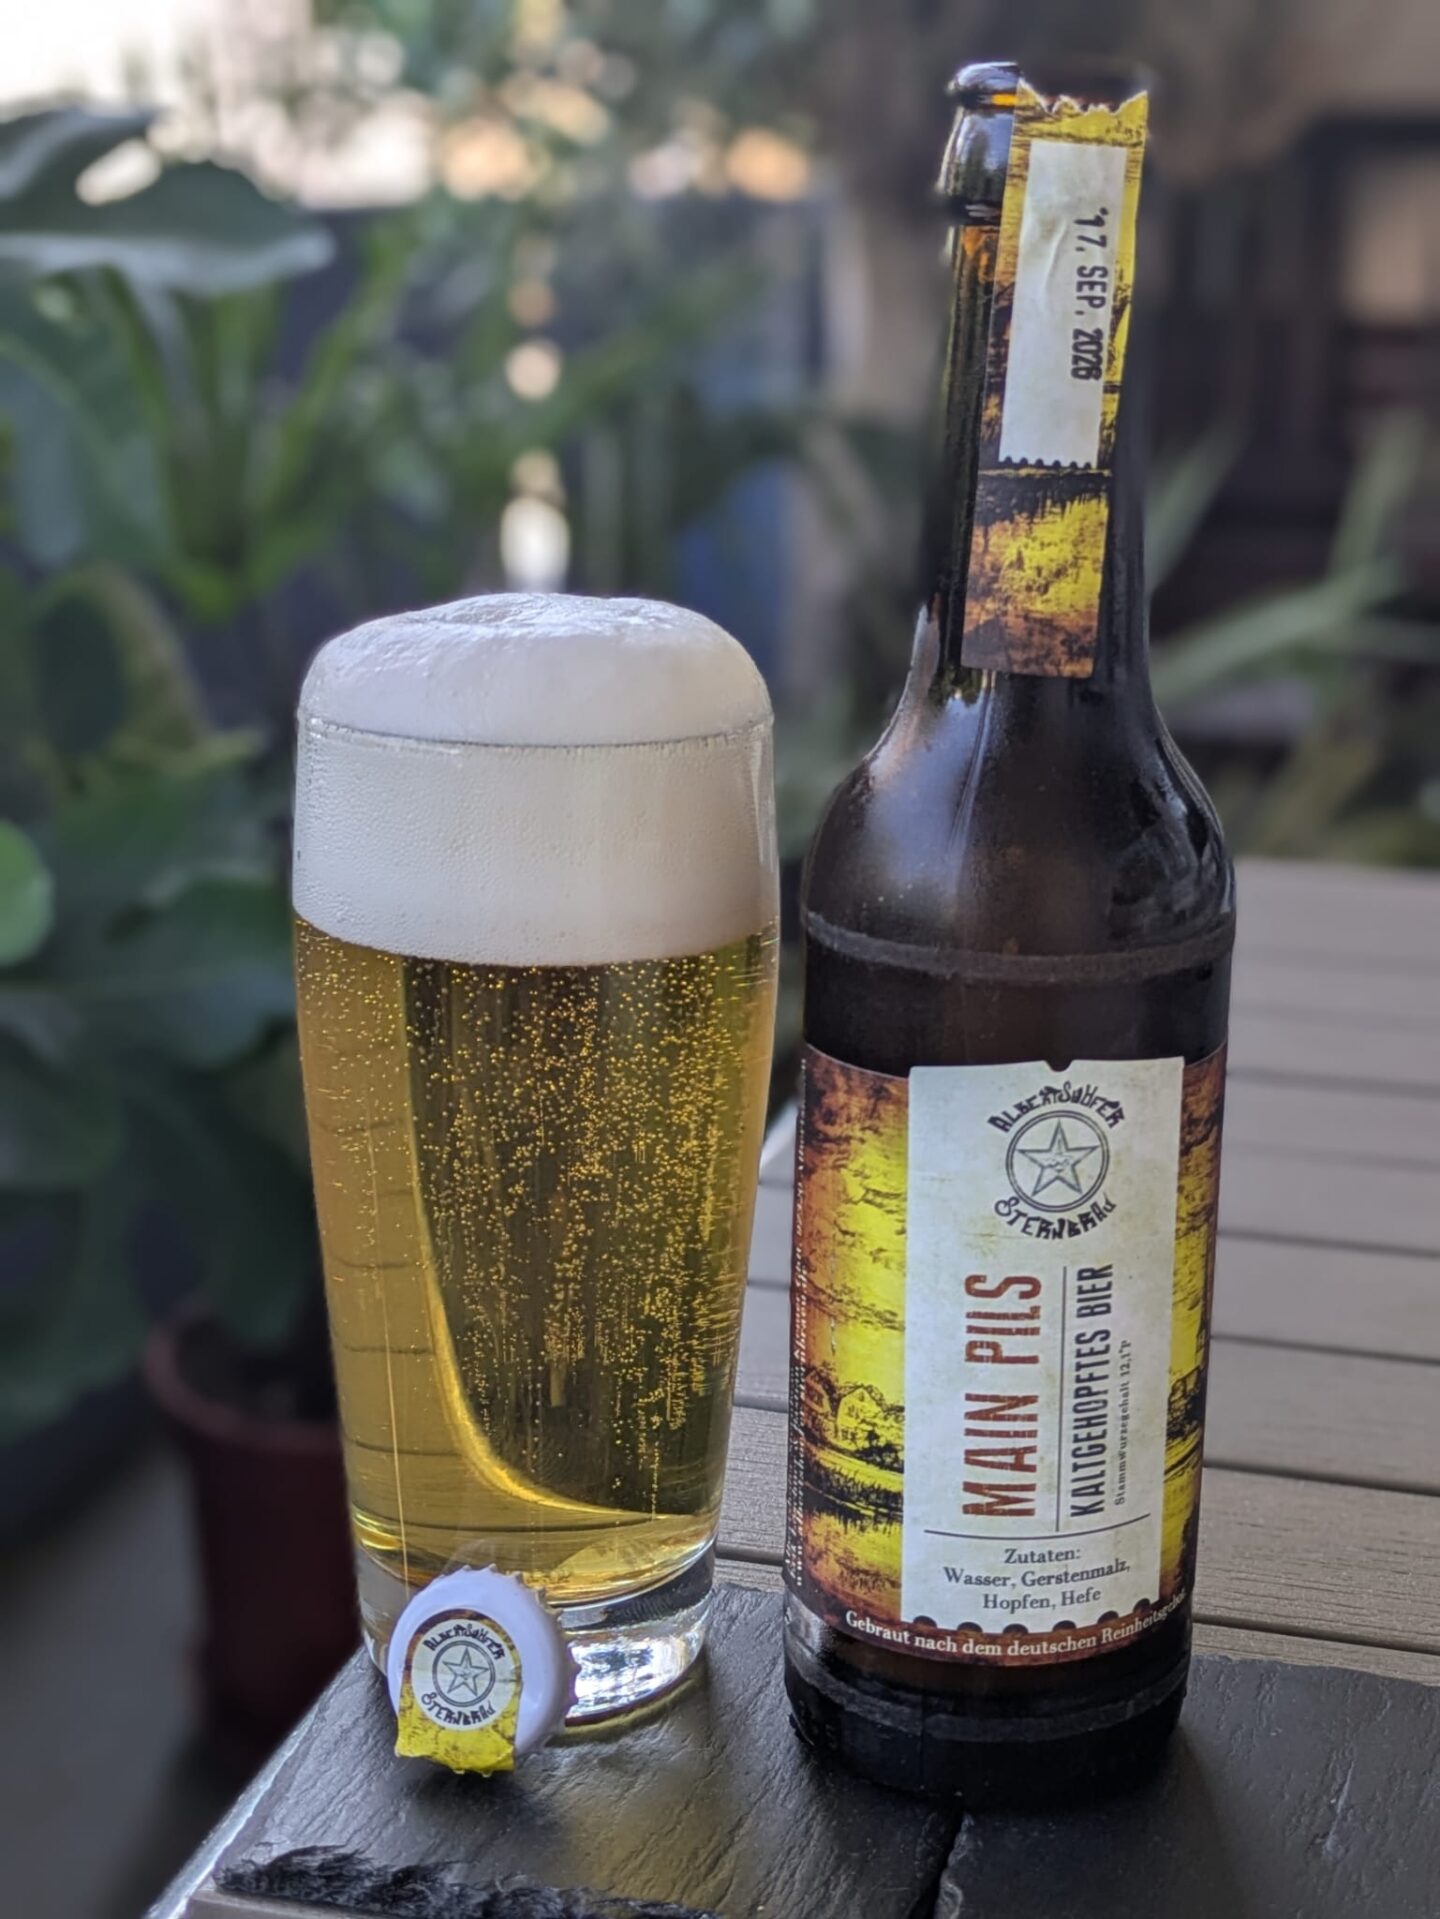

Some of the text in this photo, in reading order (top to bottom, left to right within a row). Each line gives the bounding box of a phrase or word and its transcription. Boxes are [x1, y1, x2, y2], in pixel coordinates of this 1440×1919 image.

[1075, 265, 1109, 315] SEP.
[962, 1274, 1042, 1517] MAIN PILS
[1070, 1264, 1113, 1517] KALTGEHOPFTES BIER
[943, 1558, 1131, 1589] Wasser, Gerstenmalz,
[1004, 1549, 1081, 1565] Zutaten:
[983, 1588, 1102, 1614] Hopfen, Hefe
[846, 1610, 910, 1645] Gebraut
[914, 1635, 958, 1653] nach
[962, 1638, 1001, 1655] dem
[1007, 1634, 1098, 1656] deutschen
